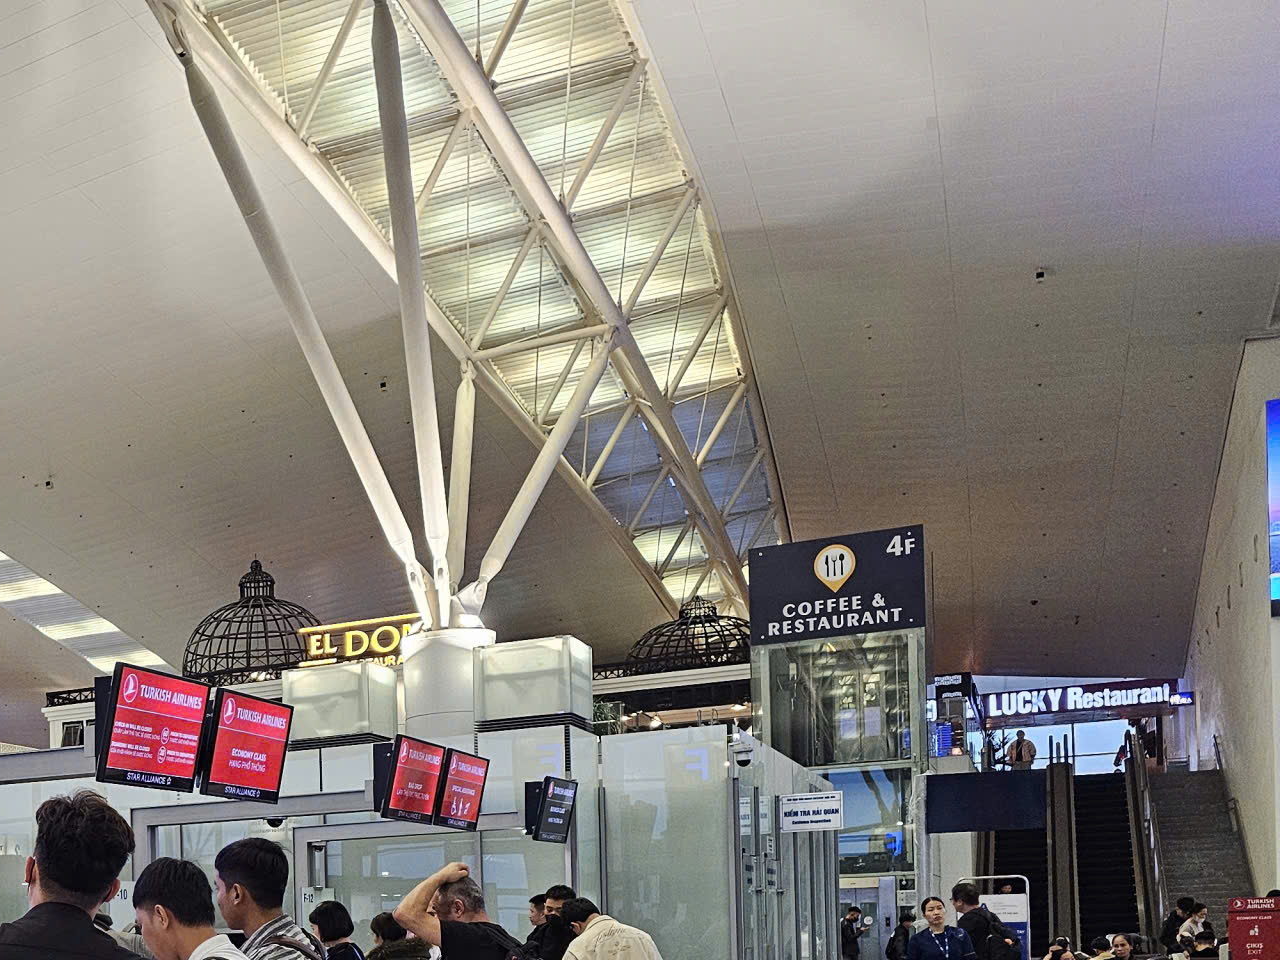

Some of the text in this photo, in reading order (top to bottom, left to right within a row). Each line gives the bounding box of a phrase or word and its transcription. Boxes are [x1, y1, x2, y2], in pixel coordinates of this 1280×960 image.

[886, 534, 916, 556] 4F
[782, 592, 887, 620] COFFEE &
[768, 607, 901, 637] RESTAURANT
[310, 623, 411, 656] EL DO
[140, 685, 202, 709] TURKISH AIRLINES
[989, 683, 1170, 716] LUCKY Restaurant
[237, 708, 286, 729] TURKISH AIRLINES
[232, 748, 267, 762] ECONOMY CLASS
[409, 749, 440, 765] TURKISH AIRLINES
[457, 761, 485, 776] TURKISH AIRLINES
[127, 772, 166, 785] STAR ALLIANCE
[225, 786, 256, 797] STAR ALLIANCE
[800, 808, 811, 816] TRA
[792, 816, 831, 825] Customs Inspection
[304, 893, 314, 903] F-12
